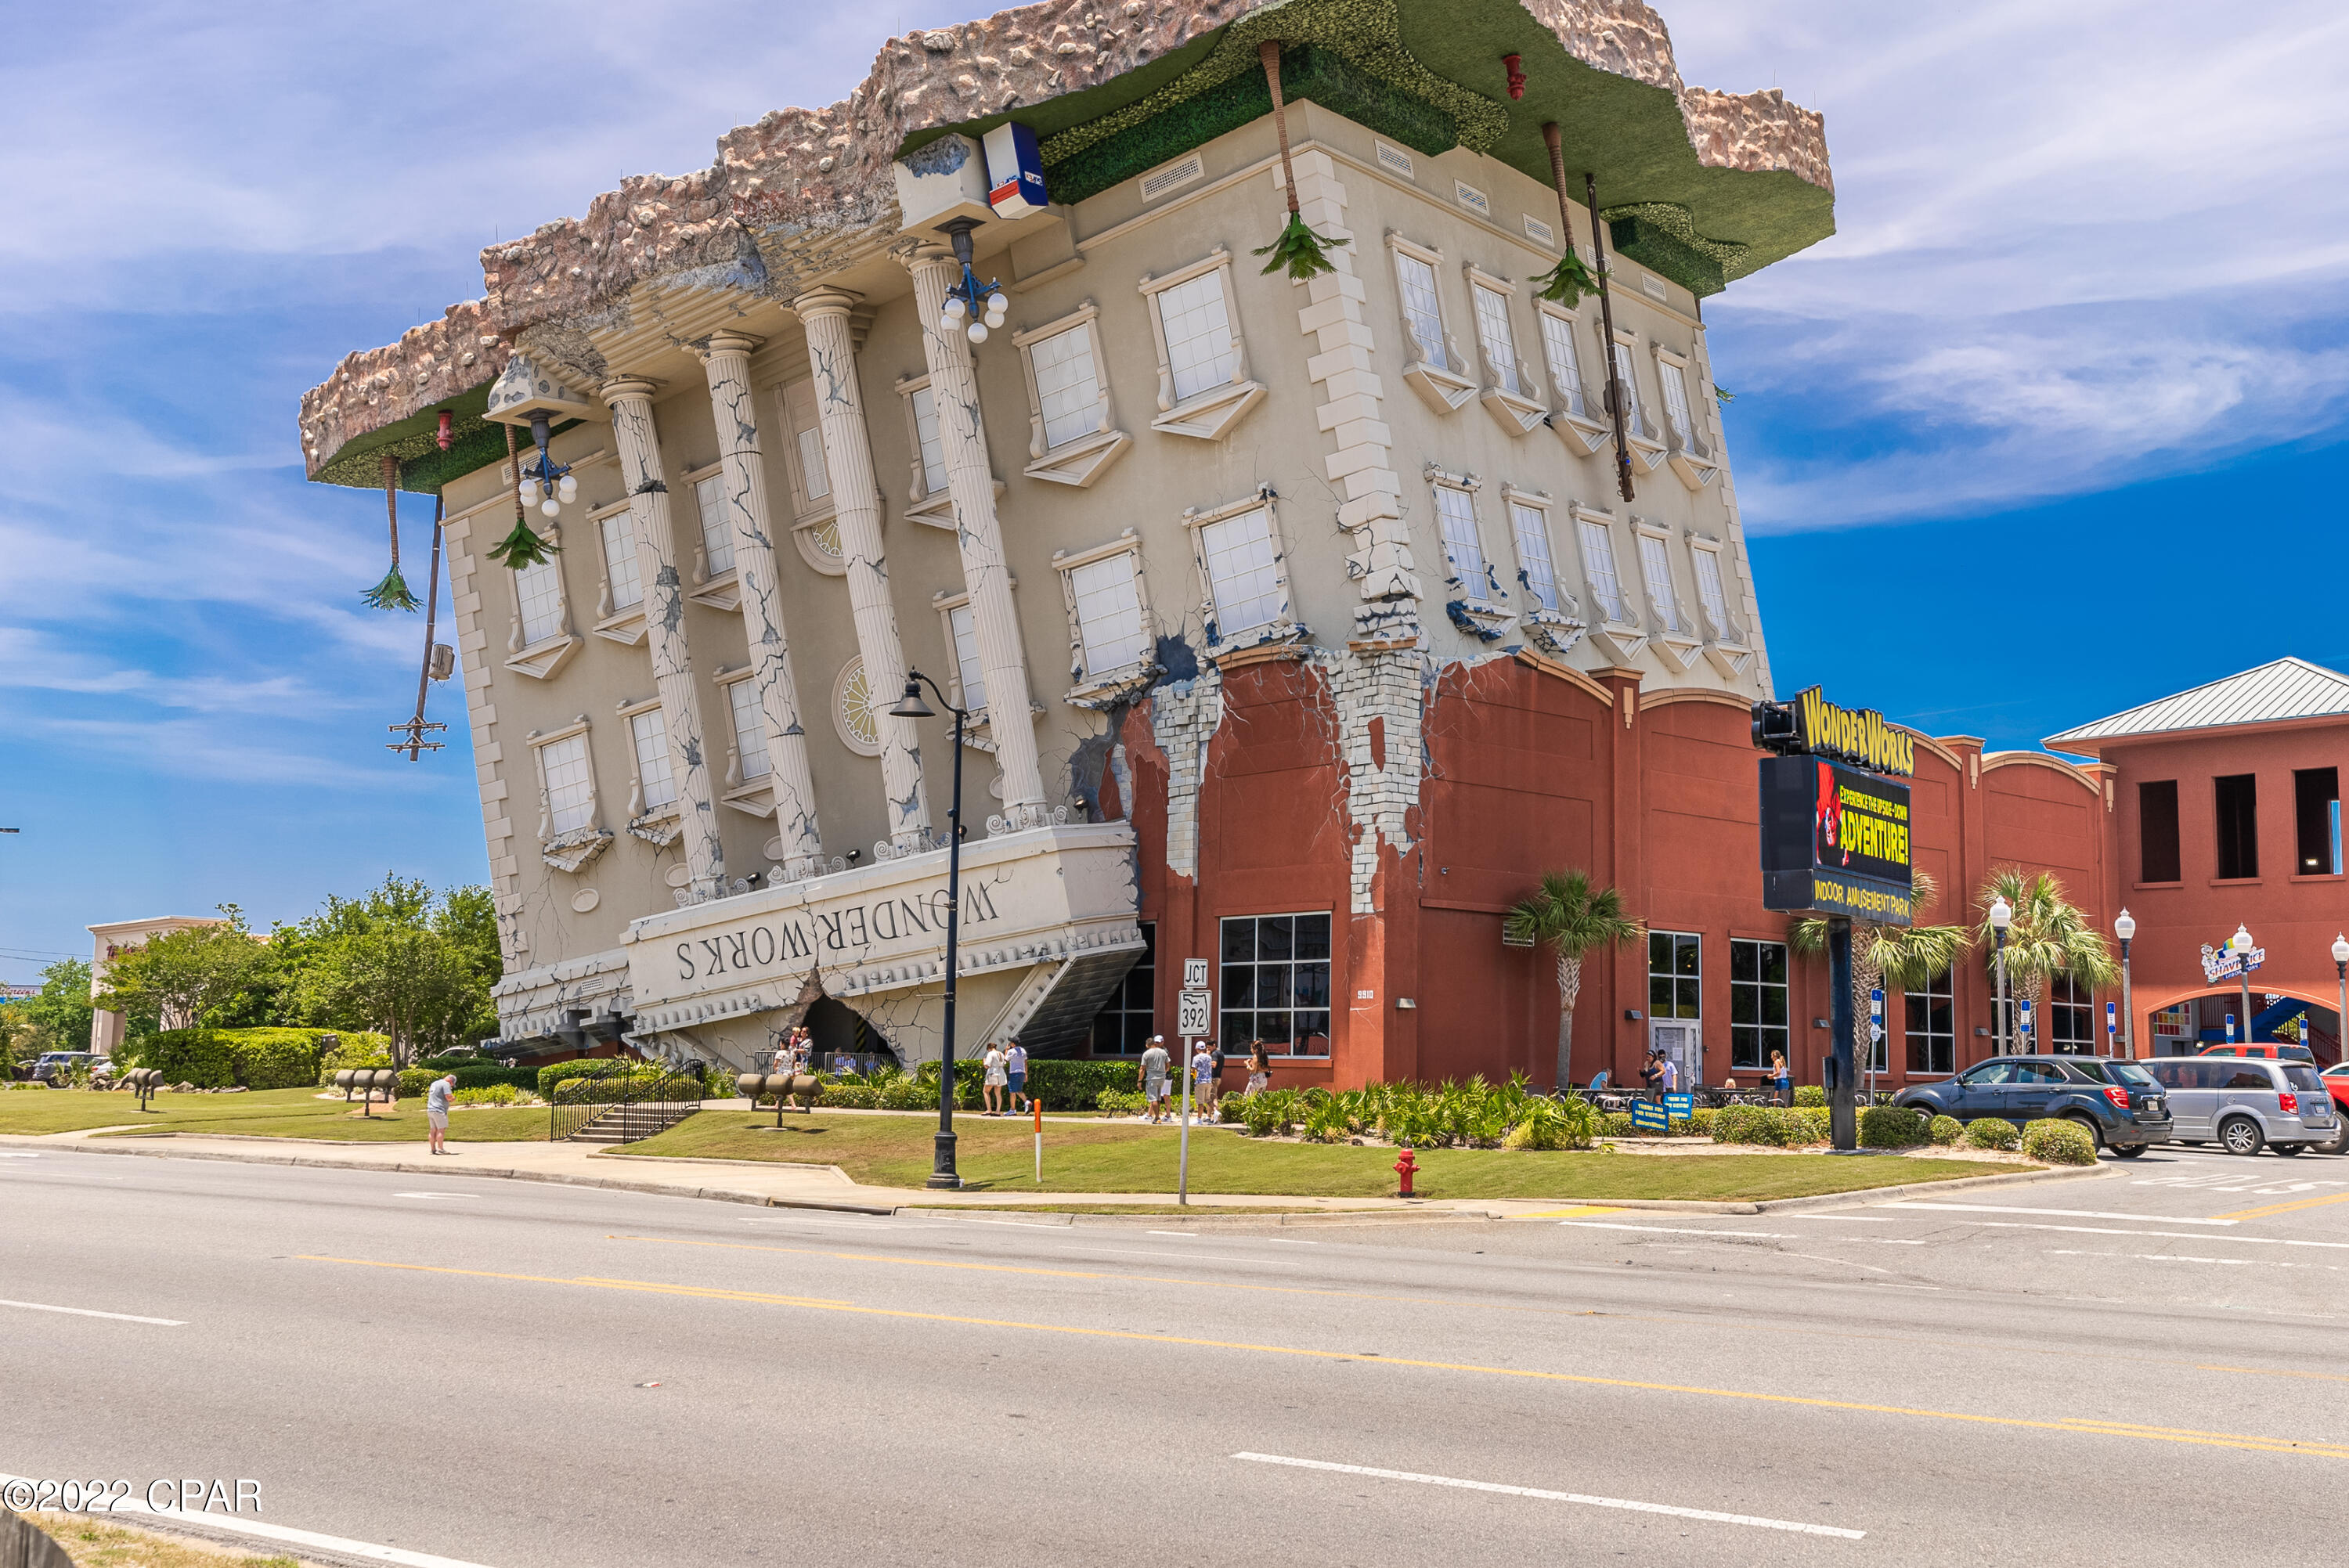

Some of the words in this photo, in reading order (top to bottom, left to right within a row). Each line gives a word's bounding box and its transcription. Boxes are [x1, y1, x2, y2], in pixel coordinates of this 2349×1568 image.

[1839, 809, 1909, 866] ADVENTURE!
[1814, 878, 1845, 905] INDOOR
[1846, 885, 1890, 913] AMUSEMENT
[1890, 894, 1911, 919] PARK
[817, 880, 1000, 951] WONDER
[676, 918, 813, 981] WORKS
[2250, 951, 2264, 964] ICE
[1185, 964, 1206, 983] JCT
[1357, 989, 1374, 1000] 9910
[1182, 1007, 1204, 1029] 392
